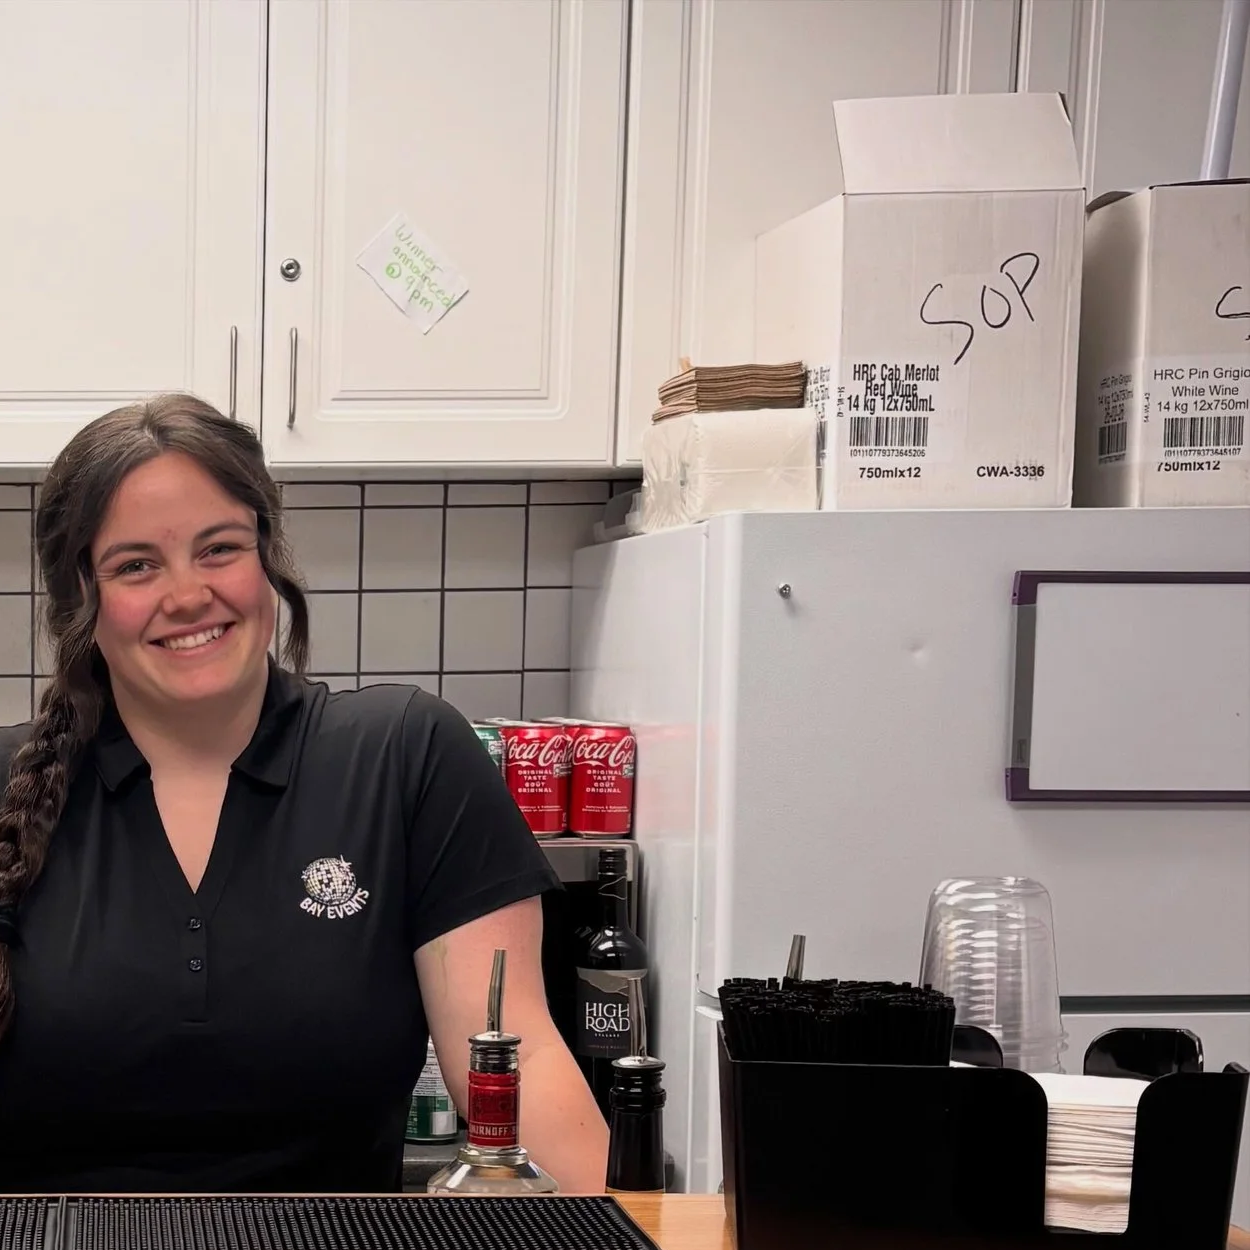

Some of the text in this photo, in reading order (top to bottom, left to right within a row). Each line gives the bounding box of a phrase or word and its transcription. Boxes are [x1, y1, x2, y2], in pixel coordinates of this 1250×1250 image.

[920, 252, 1039, 365] SOP
[853, 364, 940, 382] HRC Cab Merlot
[1153, 369, 1185, 380] HRC
[1188, 368, 1209, 379] Pin
[865, 379, 918, 397] Red Wine
[1171, 384, 1239, 397] White Wine
[847, 395, 935, 415] 14 kg 12x750mL
[1157, 401, 1171, 412] 14
[1174, 400, 1188, 414] kg
[859, 466, 921, 478] 750mlx12
[976, 465, 1045, 478] CWA-3336
[300, 887, 369, 919] BAY EVENTS
[585, 1002, 630, 1017] HIGH
[586, 1016, 631, 1032] ROAD
